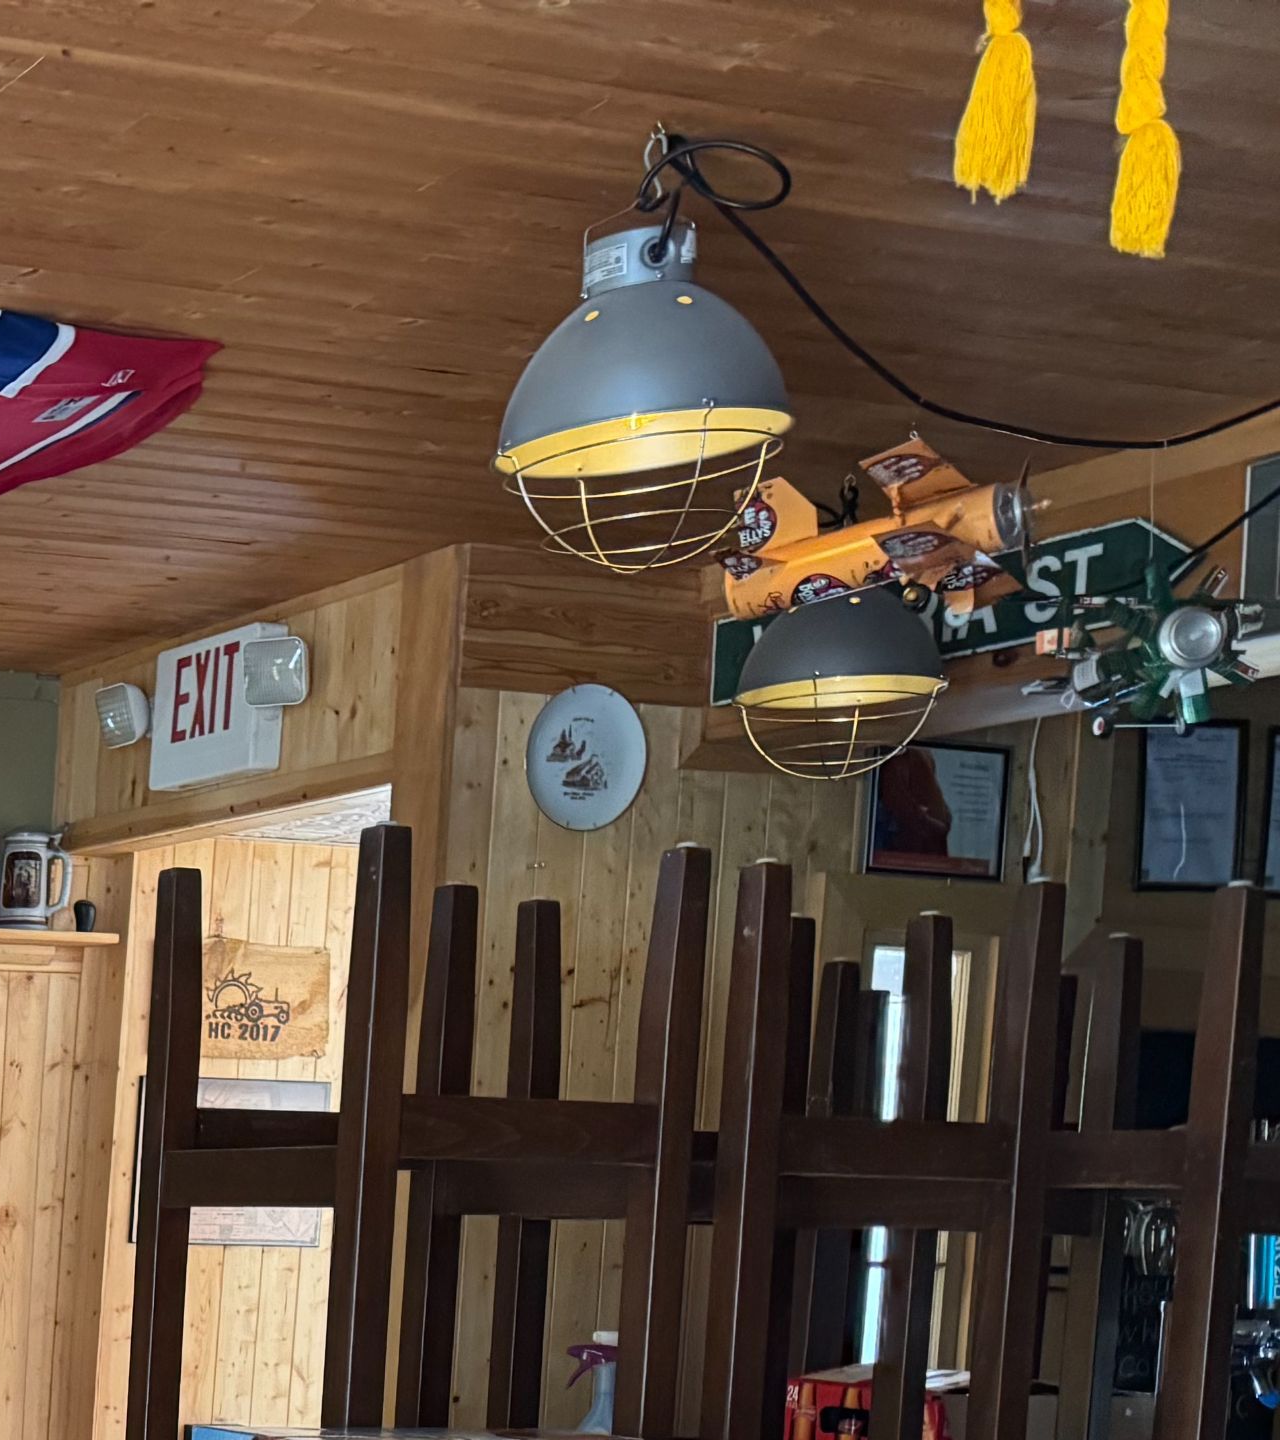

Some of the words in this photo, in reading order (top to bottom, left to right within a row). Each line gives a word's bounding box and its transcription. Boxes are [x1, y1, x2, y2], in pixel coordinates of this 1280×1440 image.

[1024, 542, 1105, 624] ST
[170, 640, 241, 744] EXIT
[208, 1021, 232, 1040] HC
[238, 1023, 281, 1042] 2017
[786, 1385, 800, 1401] 24
